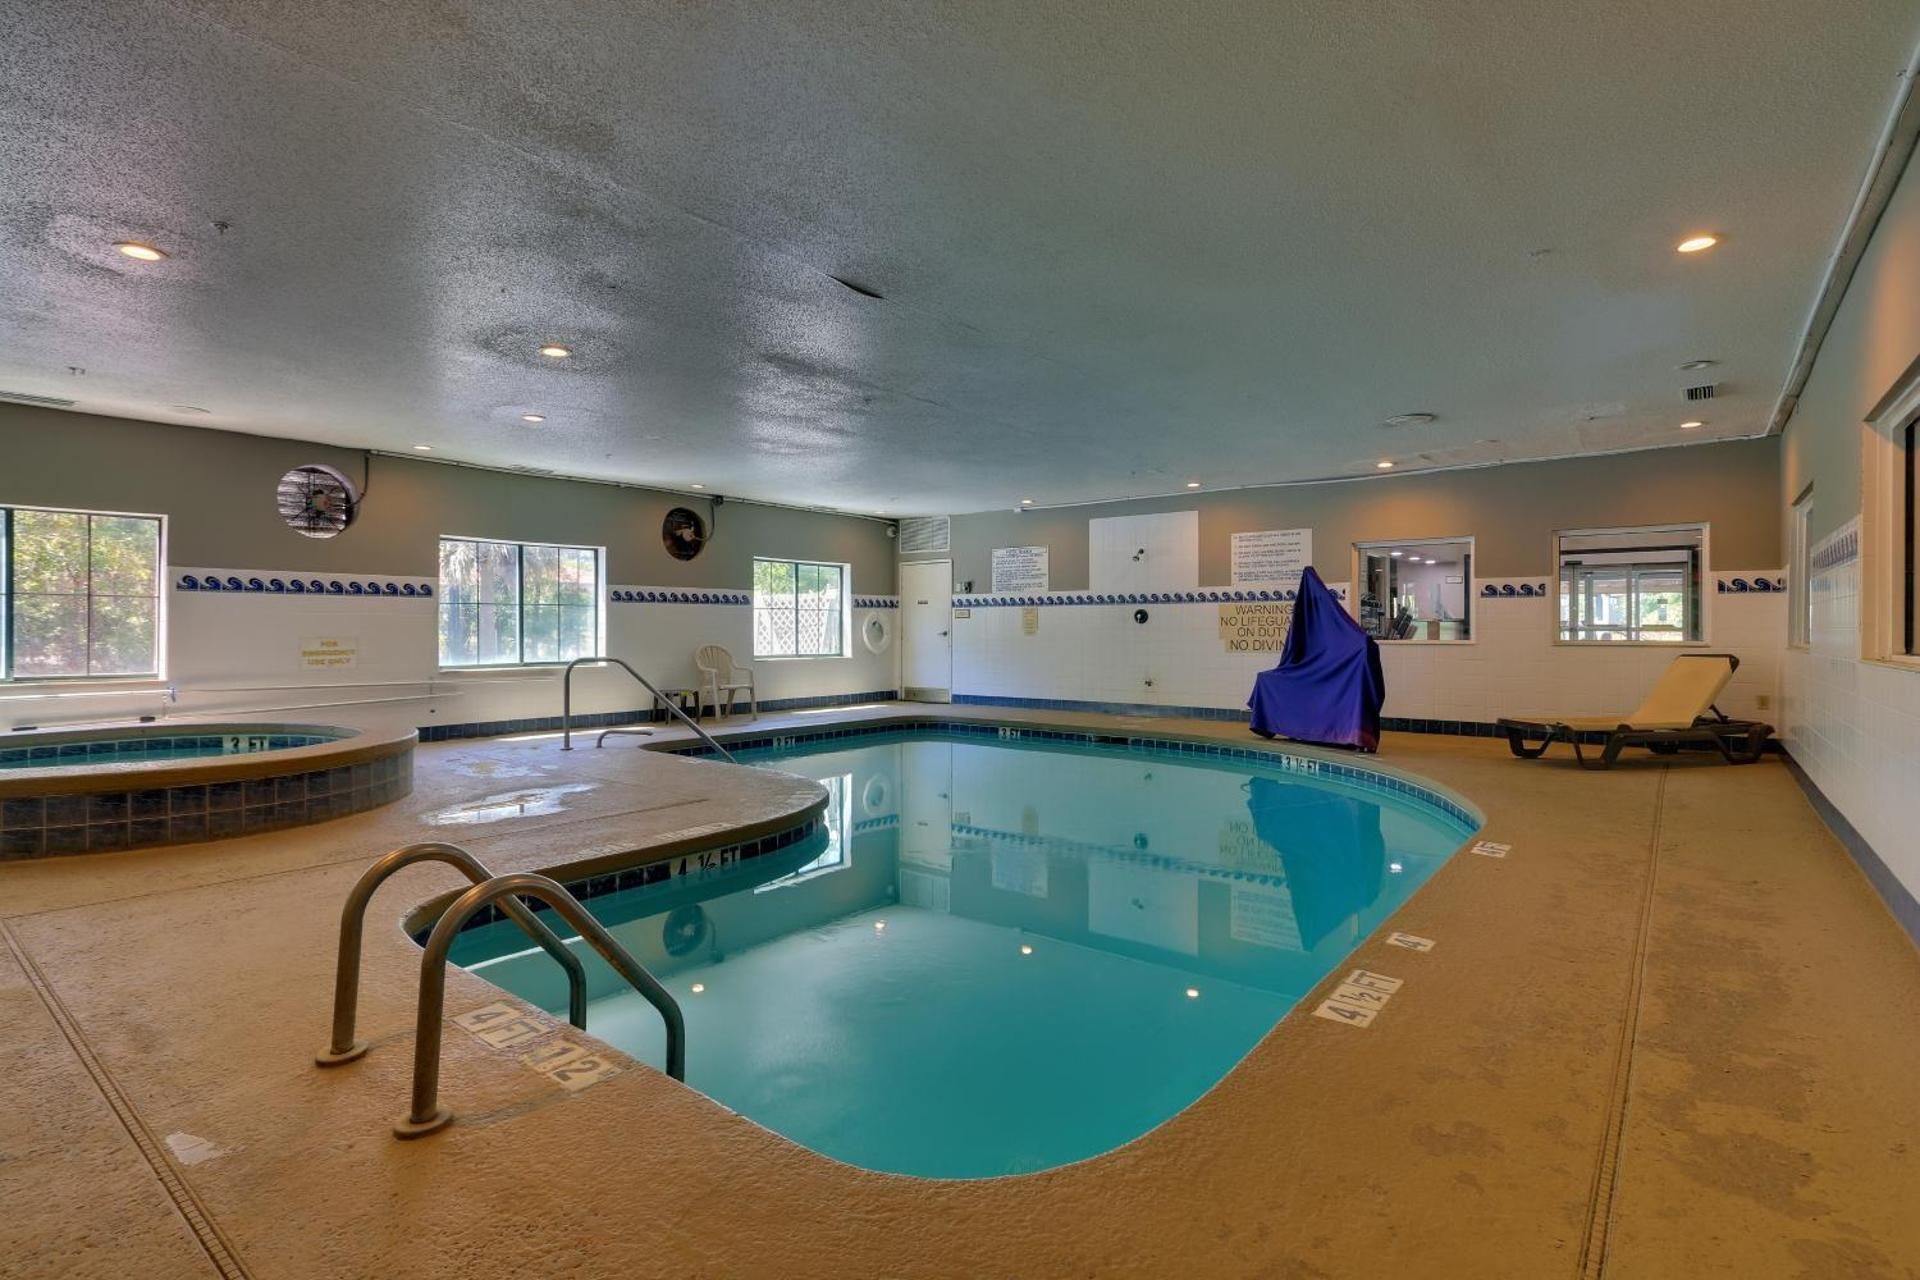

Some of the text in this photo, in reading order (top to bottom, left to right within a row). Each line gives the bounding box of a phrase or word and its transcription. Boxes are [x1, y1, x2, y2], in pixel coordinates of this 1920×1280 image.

[1235, 604, 1295, 615] WARNING
[1220, 616, 1292, 627] NO LIFEGUA
[1237, 627, 1255, 637] ON
[1229, 639, 1285, 651] NO DIVIN
[678, 857, 689, 876] 4
[720, 845, 740, 867] FT
[1326, 1005, 1370, 1021] 4
[1351, 971, 1397, 992] FT
[467, 1010, 508, 1026] 4
